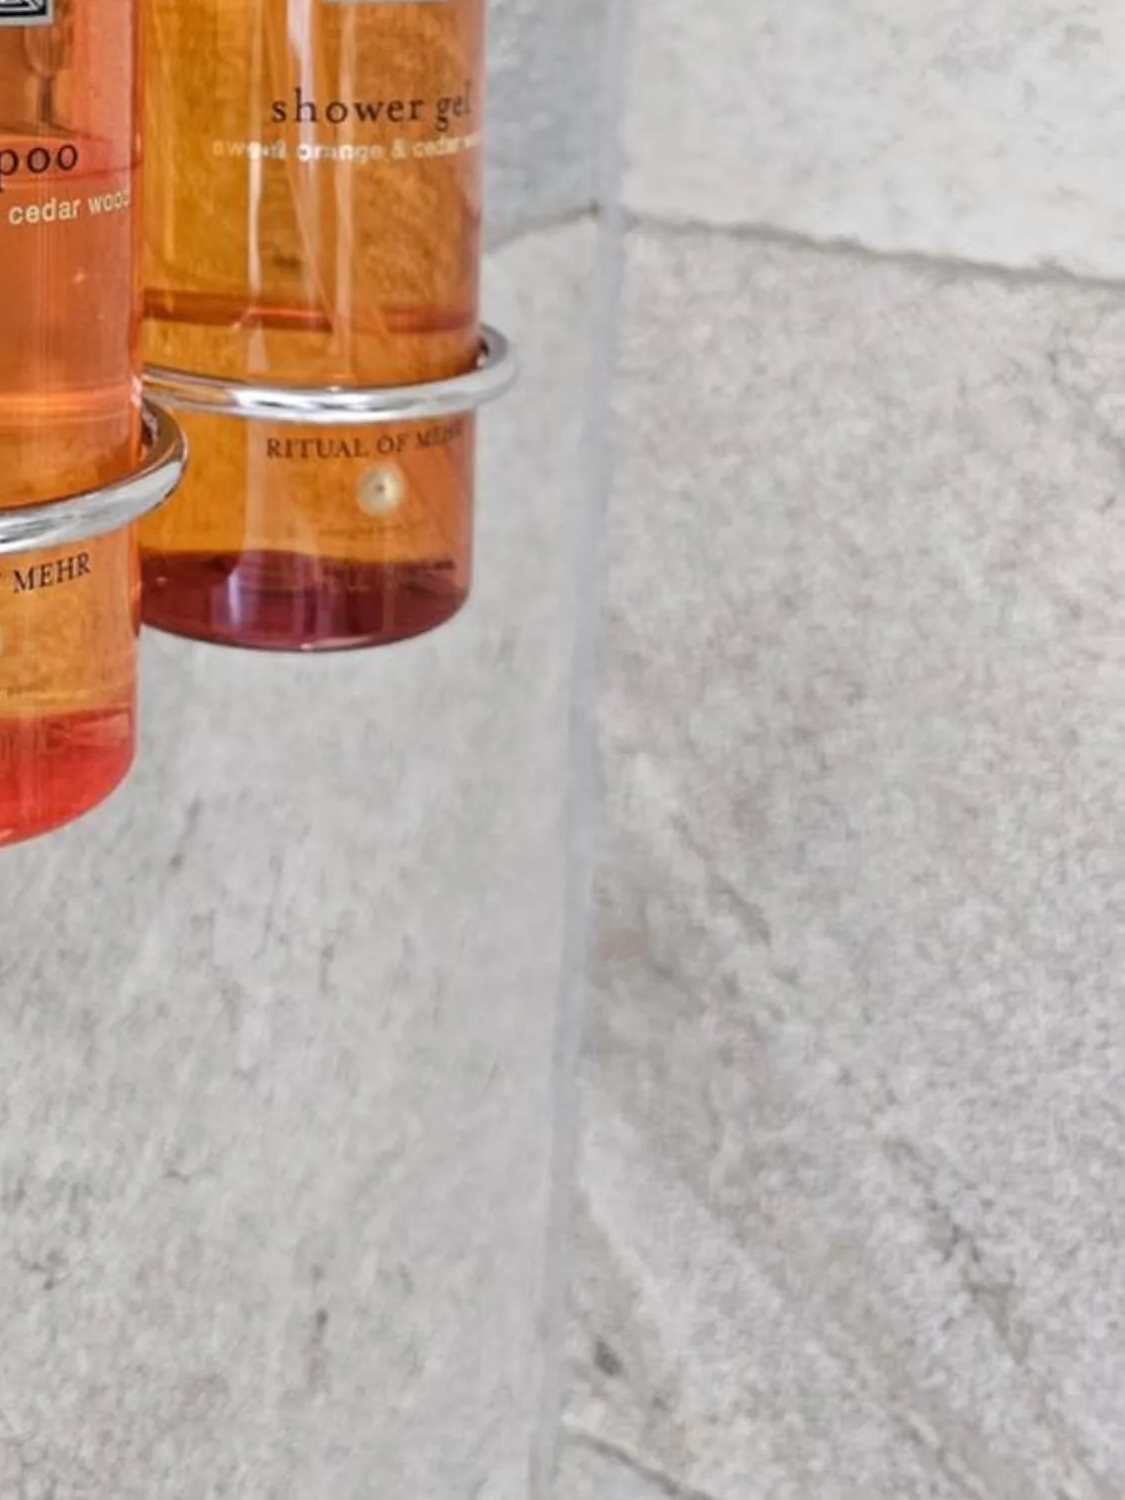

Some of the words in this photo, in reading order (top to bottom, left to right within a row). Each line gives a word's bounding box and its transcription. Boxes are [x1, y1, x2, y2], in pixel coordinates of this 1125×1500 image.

[271, 87, 424, 124] shower
[435, 80, 472, 132] gel
[391, 138, 407, 160] &
[8, 196, 81, 225] cedar
[266, 437, 369, 459] RITUAL
[377, 431, 411, 456] OF
[12, 552, 91, 594] MEHR
